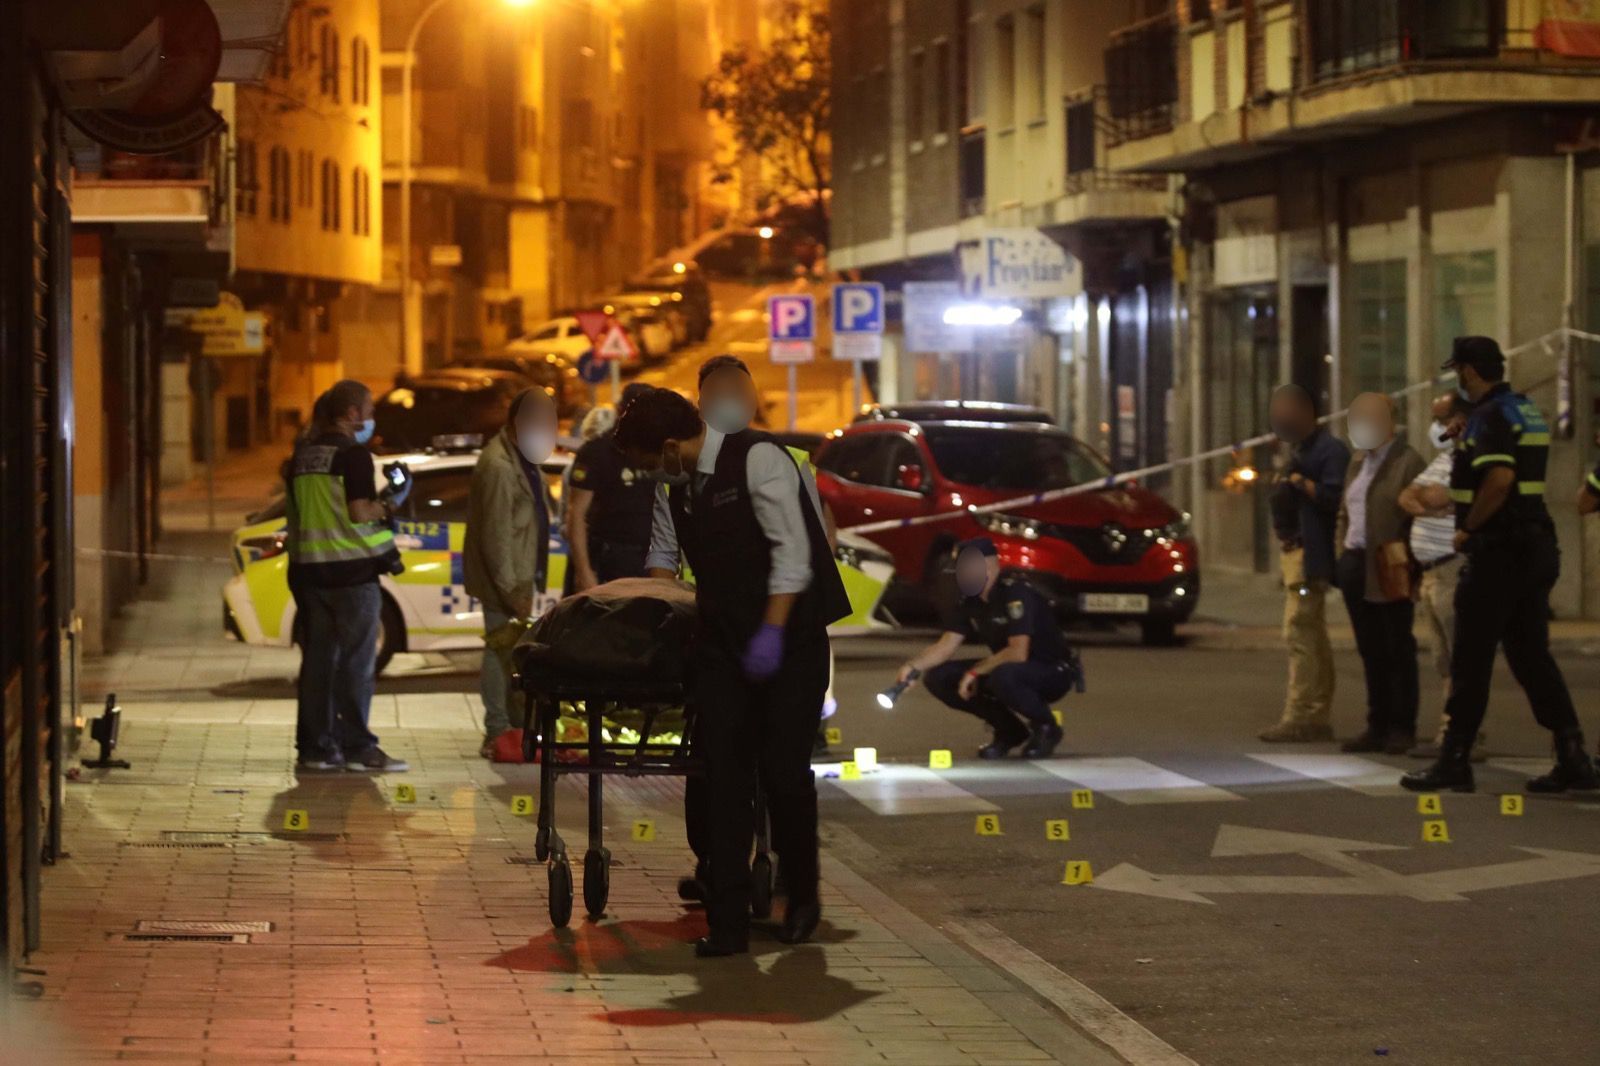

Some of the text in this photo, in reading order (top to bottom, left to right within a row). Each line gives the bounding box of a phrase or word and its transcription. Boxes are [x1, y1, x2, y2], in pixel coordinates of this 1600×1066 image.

[842, 289, 874, 328] P
[778, 300, 805, 336] P
[1076, 792, 1089, 804] 11
[1424, 798, 1435, 810] 4
[1507, 798, 1517, 811] 3
[517, 799, 526, 812] 9
[290, 813, 300, 827] 8
[984, 818, 994, 831] 6
[638, 825, 648, 837] 7
[1053, 823, 1062, 837] 5
[1430, 824, 1442, 837] 2
[1073, 864, 1081, 878] 1
